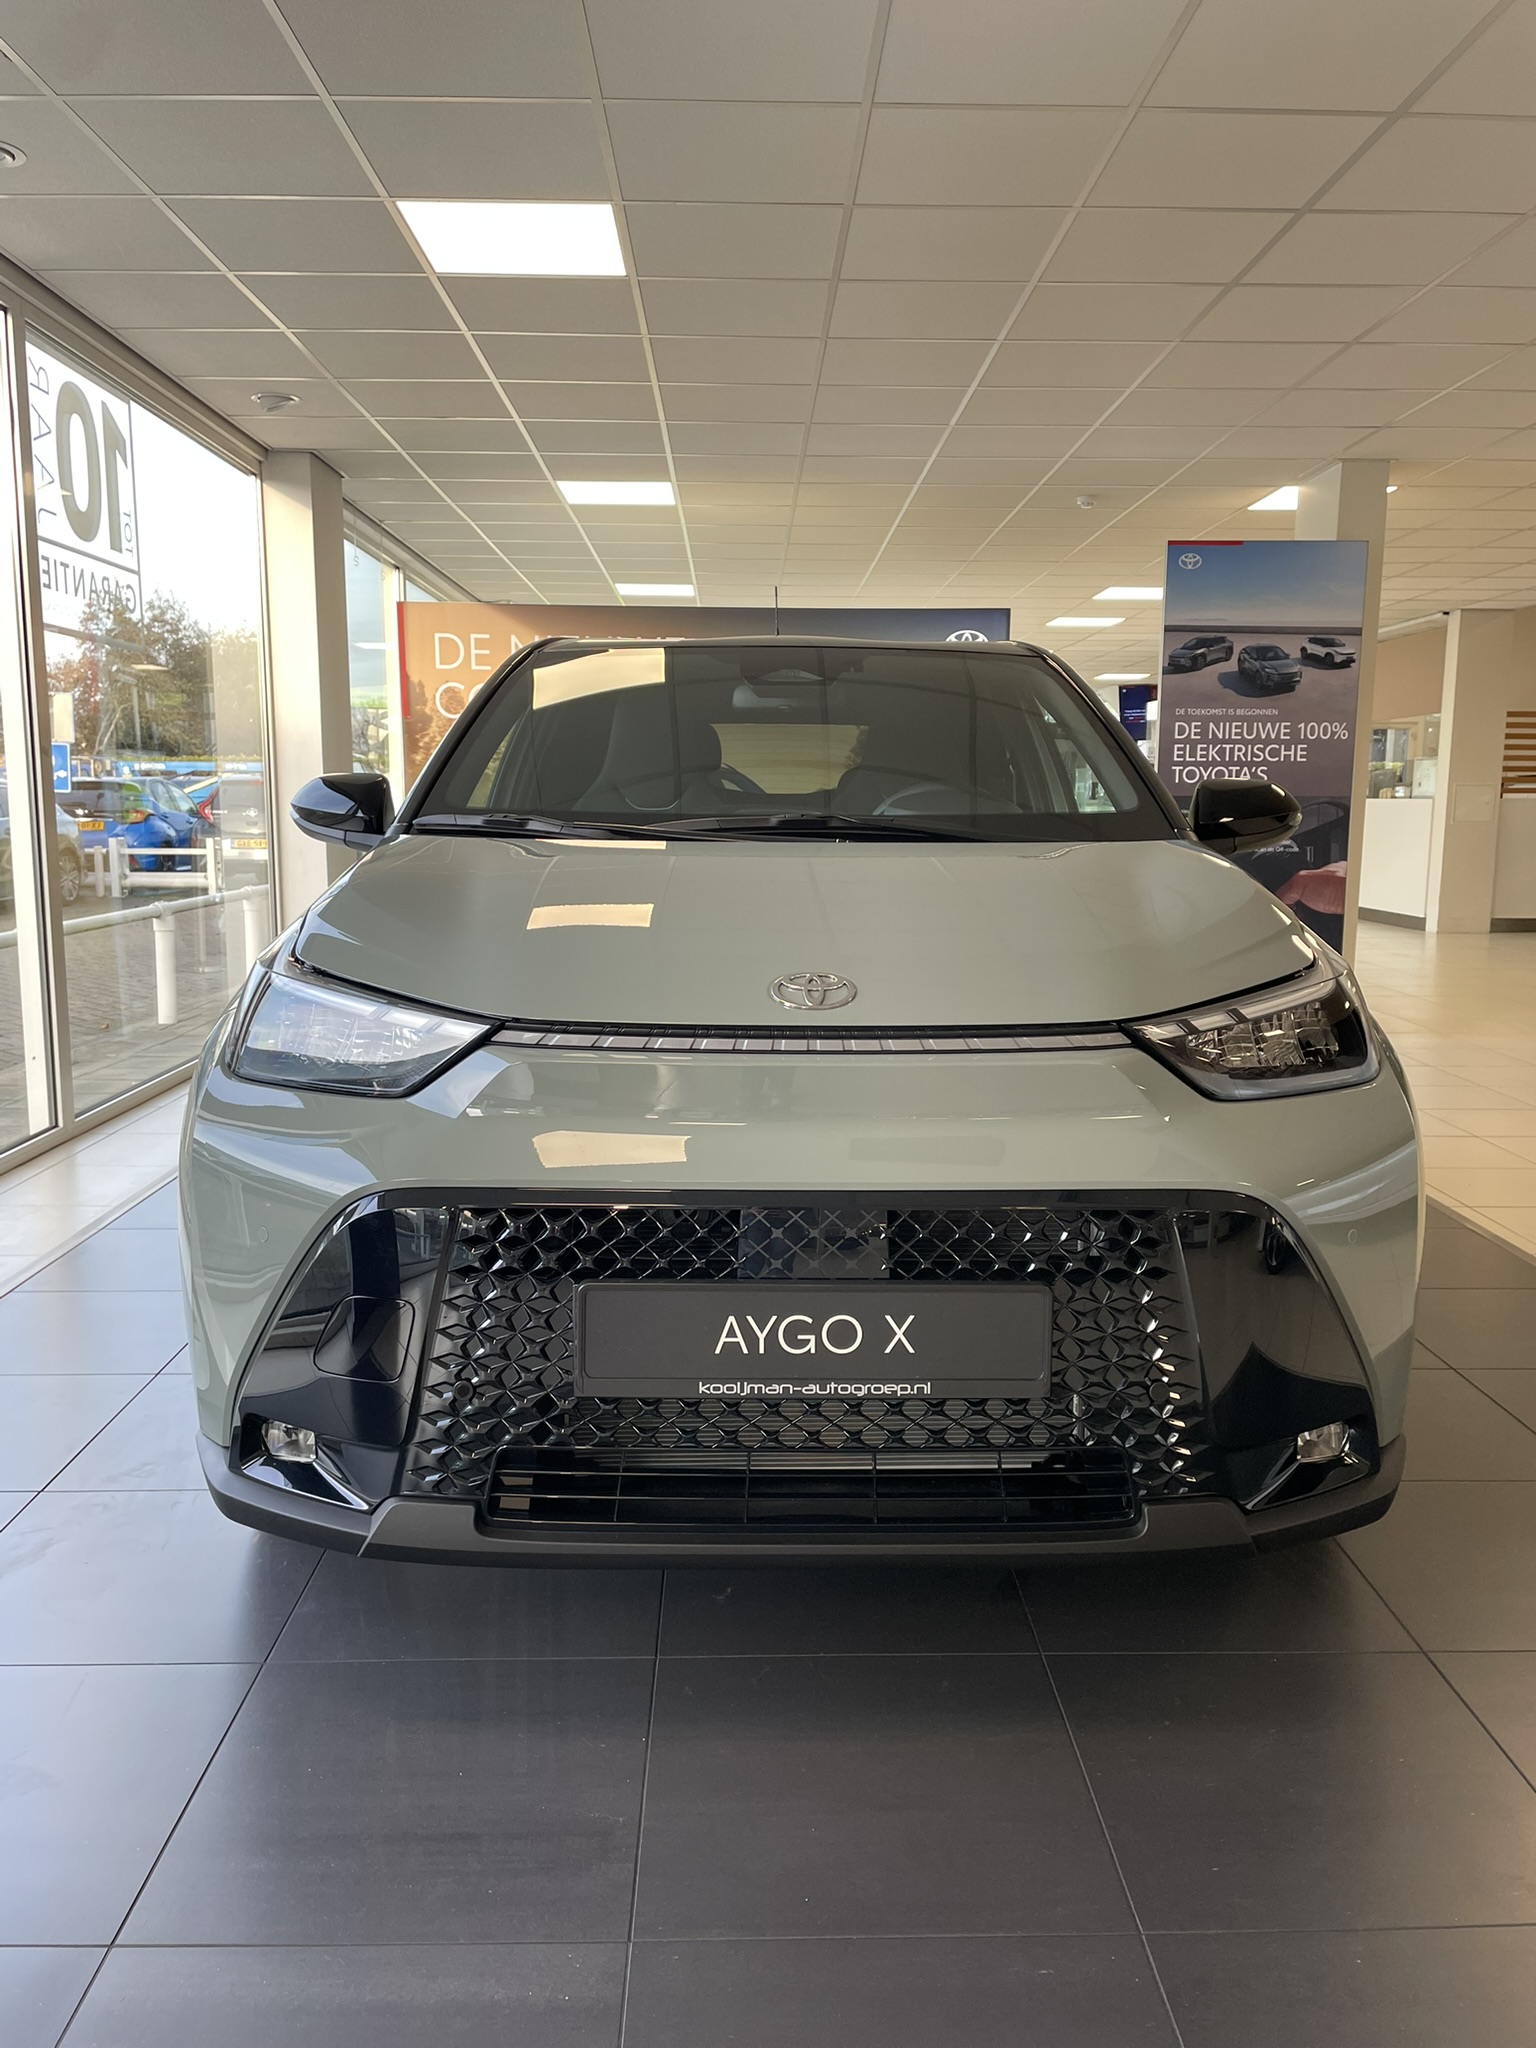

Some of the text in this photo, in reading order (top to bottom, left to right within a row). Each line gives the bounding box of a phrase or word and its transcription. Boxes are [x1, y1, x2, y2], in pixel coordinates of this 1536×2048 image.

[434, 632, 492, 671] DE
[1175, 708, 1279, 716] DE TOEKOMST IS BEGONNEN
[1174, 721, 1349, 740] DE NIEUWE 100%
[1173, 744, 1308, 762] ELEKTRISCHE
[1171, 766, 1269, 783] TOYOTA'S
[714, 1314, 916, 1355] AYGO X
[698, 1381, 932, 1397] kooijman-autogroep.nl
